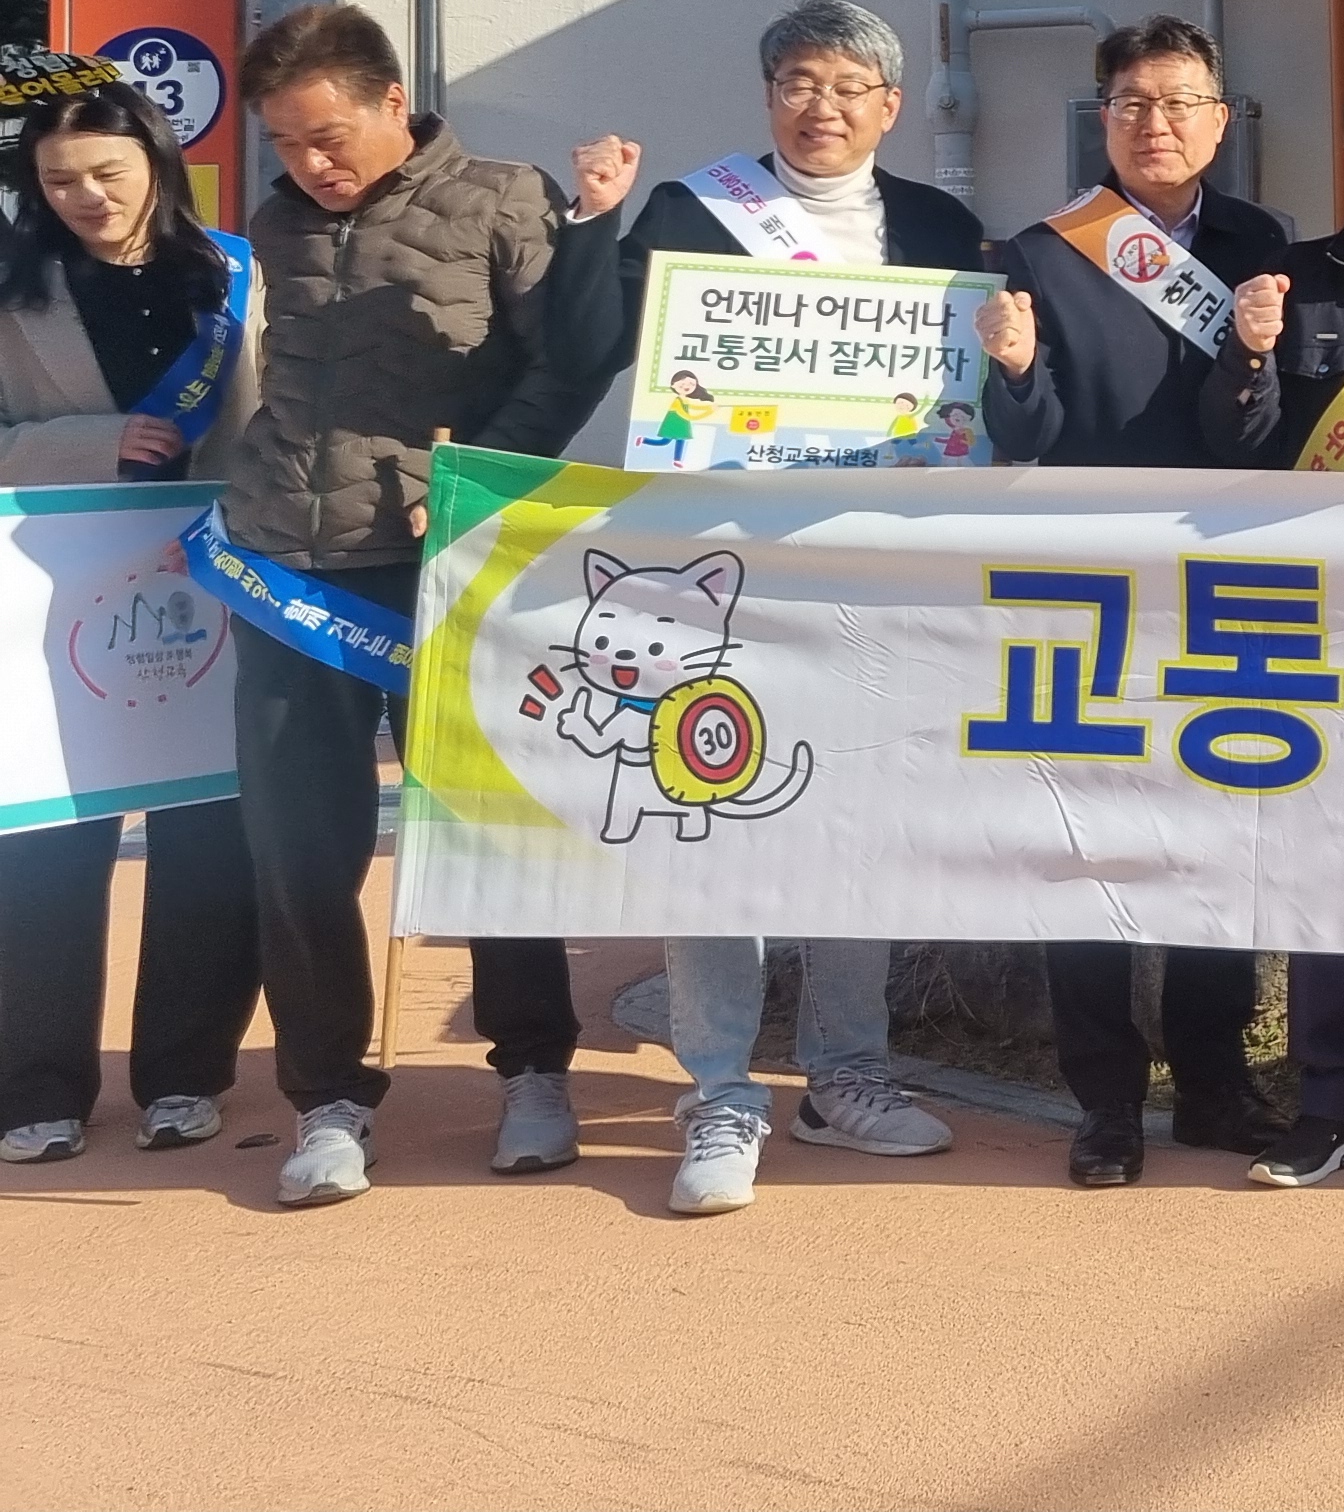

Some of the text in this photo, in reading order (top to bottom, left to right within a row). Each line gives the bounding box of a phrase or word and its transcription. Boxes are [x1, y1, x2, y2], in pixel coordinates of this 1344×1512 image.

[706, 163, 768, 215] 아동학대
[759, 213, 799, 249] 빼기
[700, 287, 957, 338] 언제나 어디서나
[674, 331, 970, 381] 교통질서 잘지키자
[746, 444, 879, 467] 산청교육지원청
[699, 721, 733, 756] 30
